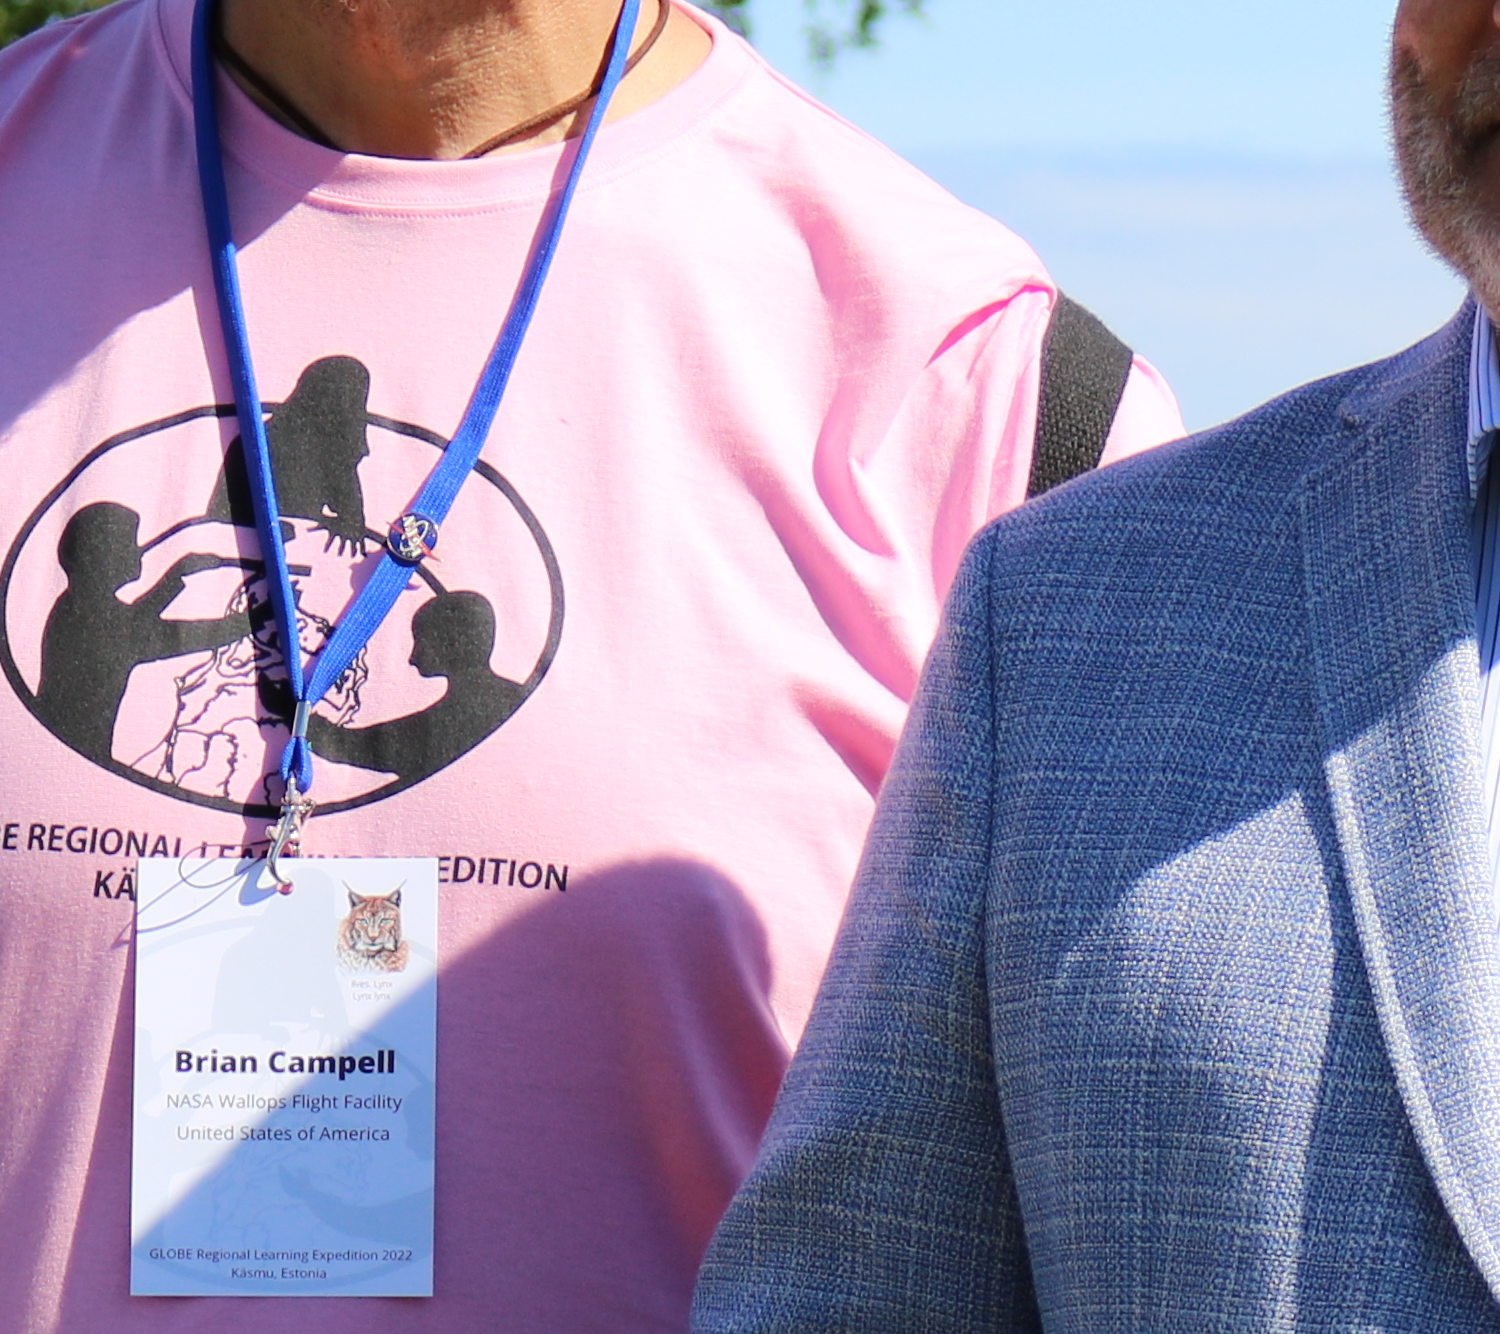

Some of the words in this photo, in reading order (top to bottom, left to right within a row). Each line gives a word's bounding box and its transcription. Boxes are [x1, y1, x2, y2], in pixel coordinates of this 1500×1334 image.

[439, 855, 569, 893] EDITION
[175, 1049, 258, 1073] Brian
[268, 1049, 395, 1081] Campell
[166, 1094, 213, 1109] NASA
[219, 1094, 287, 1113] Wallops
[292, 1094, 339, 1113] Flight
[344, 1094, 402, 1113] Facility
[177, 1125, 234, 1141] United
[239, 1125, 292, 1141] States
[297, 1125, 316, 1141] of
[319, 1125, 390, 1141] America
[150, 1248, 192, 1261] GLOBE
[197, 1248, 250, 1264] Regional
[254, 1248, 308, 1264] Learning
[312, 1249, 378, 1264] Expedition
[382, 1249, 413, 1262] 2022
[281, 1267, 327, 1280] Estonia
